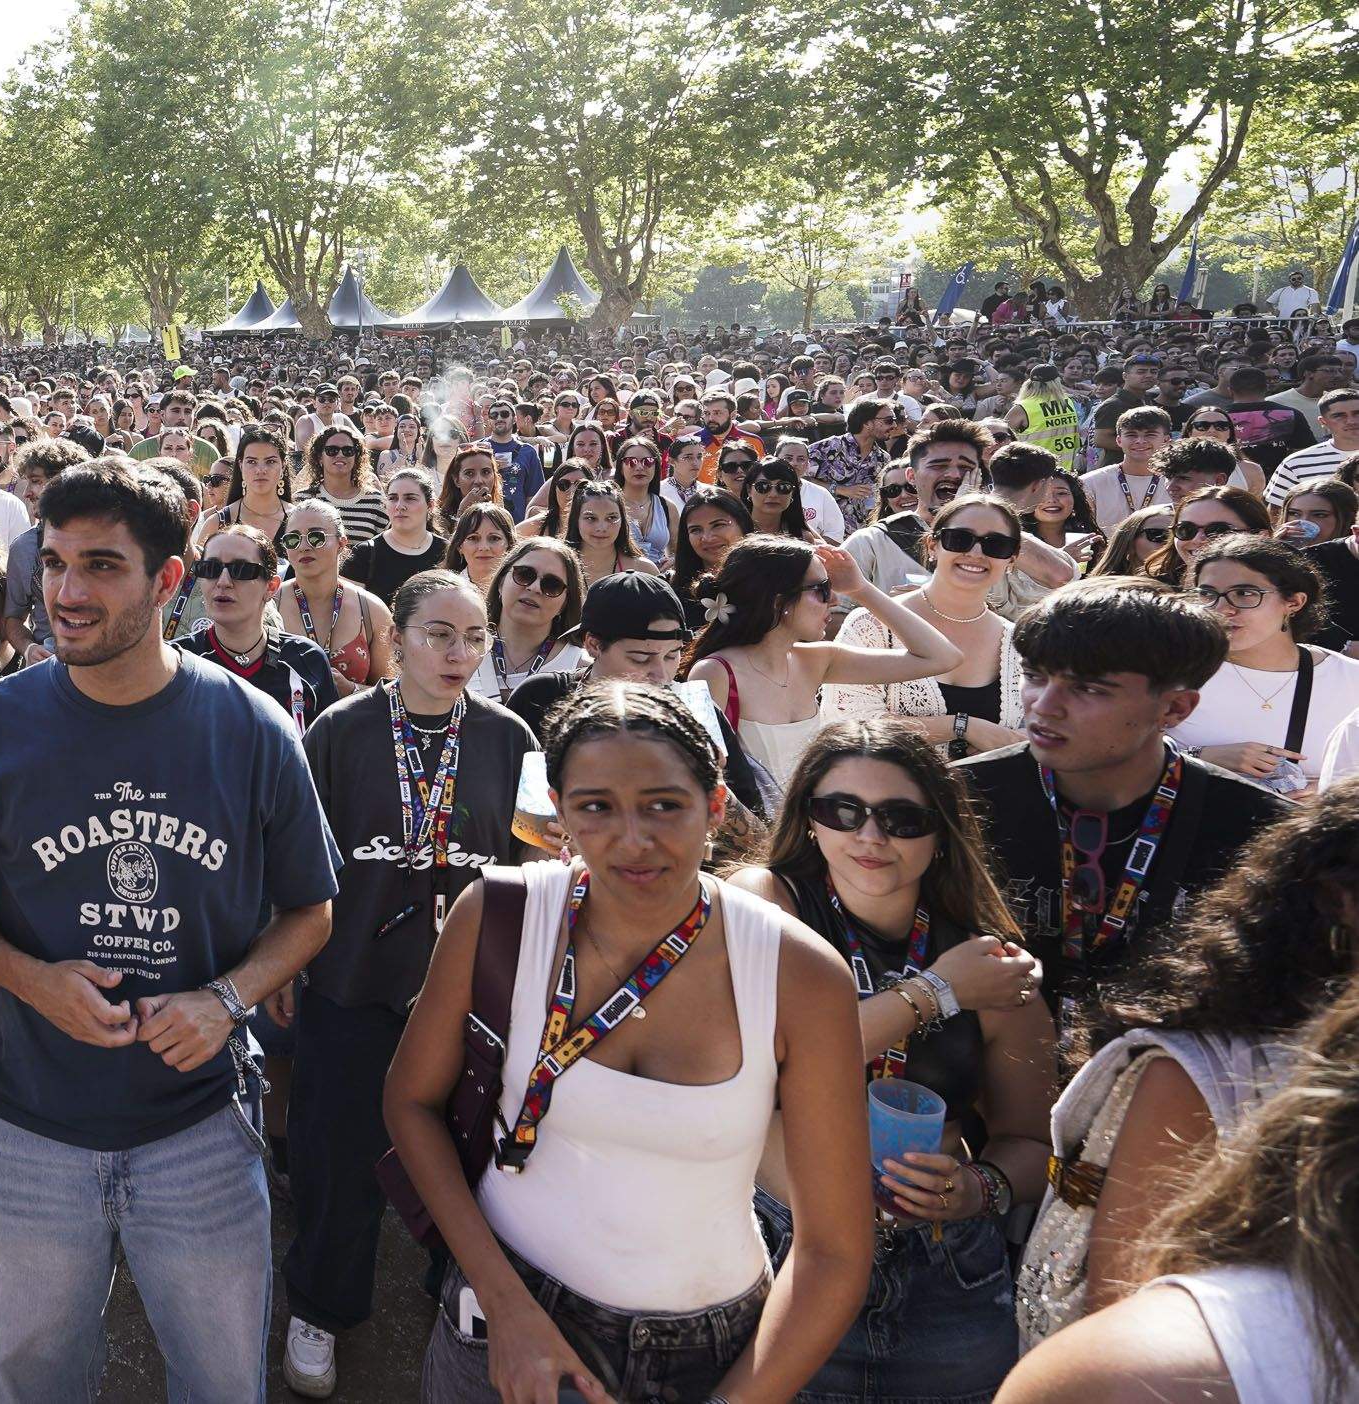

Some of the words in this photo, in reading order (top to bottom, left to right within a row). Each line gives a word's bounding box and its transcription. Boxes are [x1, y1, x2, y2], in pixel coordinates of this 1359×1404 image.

[1045, 415, 1077, 428] NORTE
[113, 781, 145, 802] The
[31, 808, 228, 872] ROASTERS
[110, 845, 127, 878] COFFEE
[128, 844, 144, 854] AND
[116, 885, 138, 900] SHOP
[79, 902, 181, 933] STWD
[93, 934, 150, 951] COFFEE
[152, 940, 175, 953] CO.
[151, 956, 177, 965] LONDON
[136, 968, 161, 980] UNIDO
